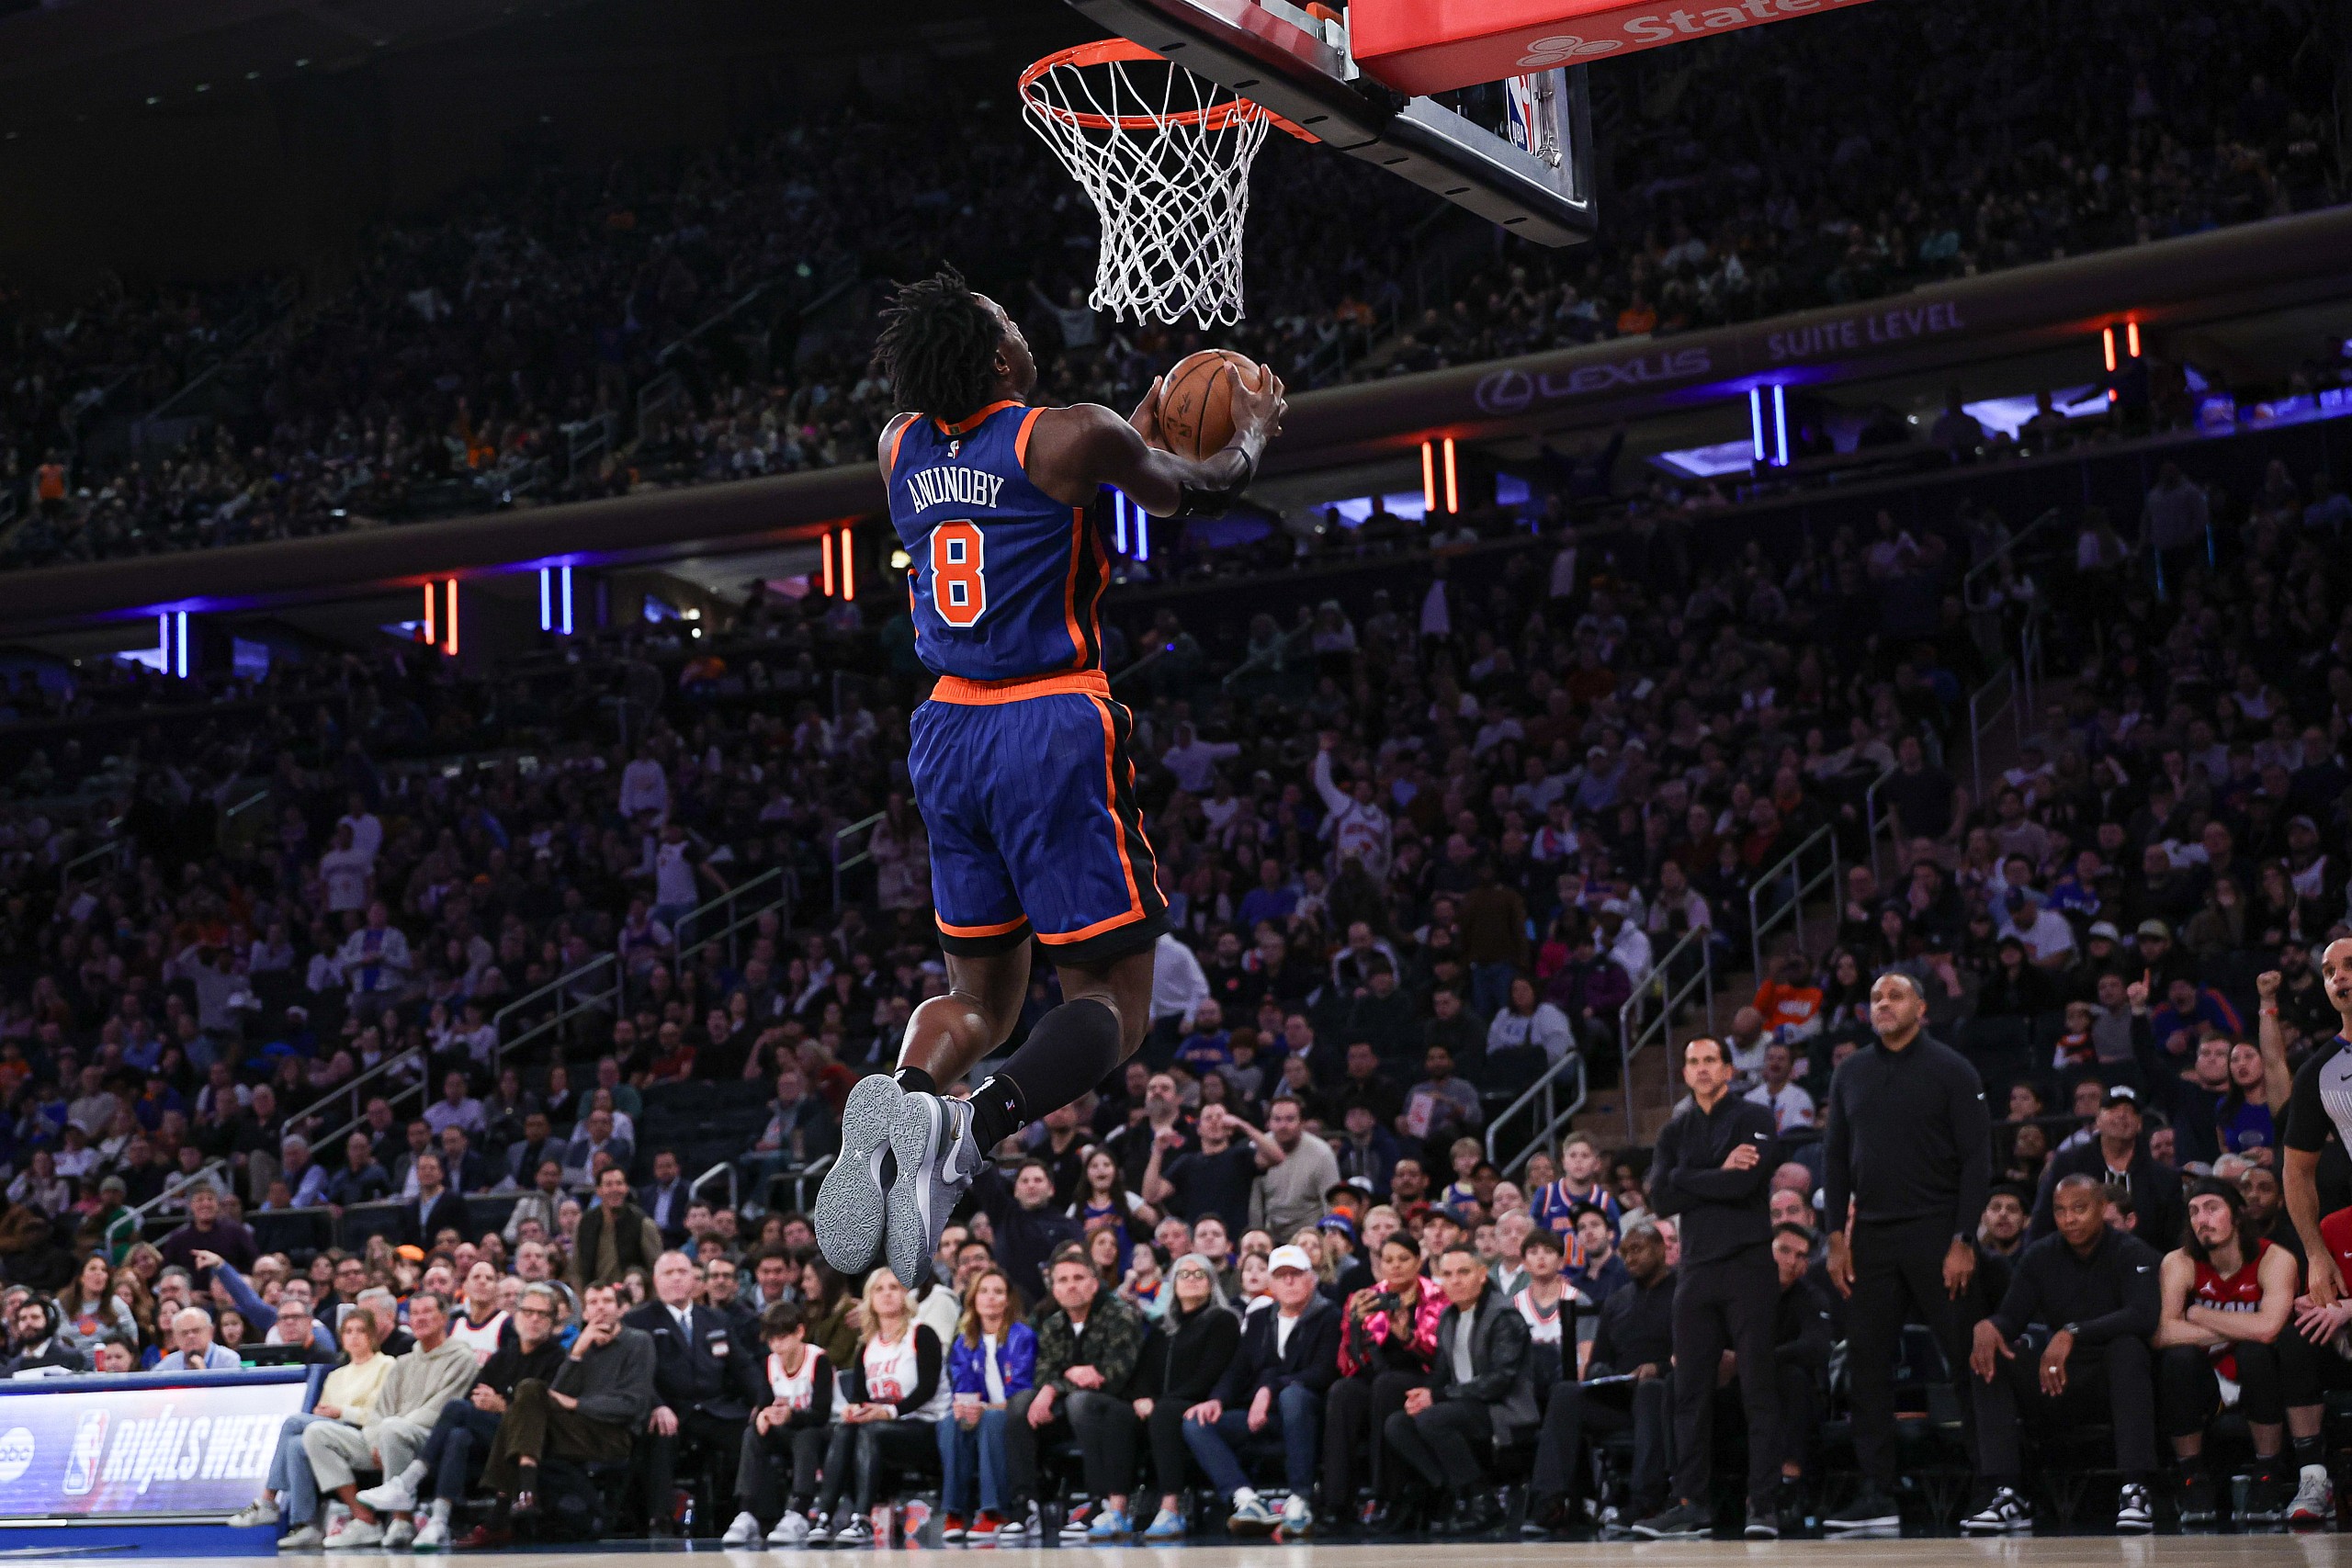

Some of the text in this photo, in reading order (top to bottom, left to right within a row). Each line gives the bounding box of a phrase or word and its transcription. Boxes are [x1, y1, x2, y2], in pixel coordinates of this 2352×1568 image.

[1511, 119, 1525, 145] NBA
[1538, 301, 1965, 398] LEXUS SUITE LEVEL
[906, 466, 1005, 514] ANUNOBY
[929, 518, 987, 628] 8
[101, 1404, 284, 1495] RIVALS WEE
